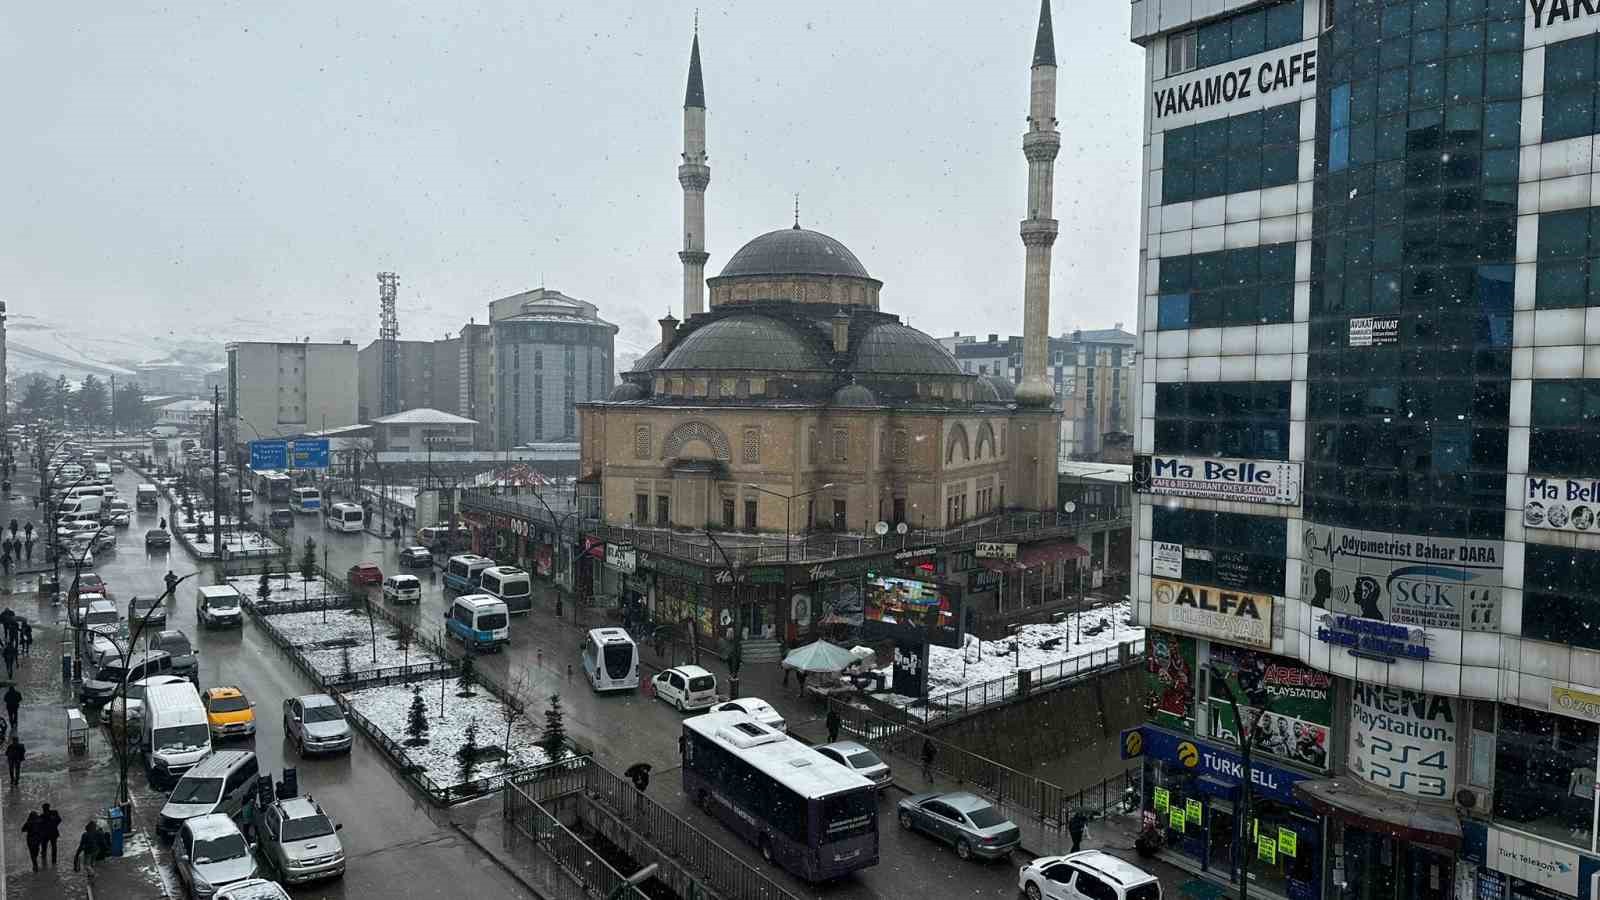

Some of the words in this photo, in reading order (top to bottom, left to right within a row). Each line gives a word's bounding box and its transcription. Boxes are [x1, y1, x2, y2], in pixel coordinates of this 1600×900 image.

[1529, 0, 1600, 29] YAK
[1154, 66, 1252, 119] YAKAMOZ
[1257, 49, 1317, 95] CAFE
[1373, 319, 1399, 330] AVUKAT
[1154, 458, 1193, 479] Ma
[1204, 460, 1272, 484] Belle
[1177, 481, 1222, 492] RESTAURANT
[1243, 486, 1276, 496] SALONU
[1529, 478, 1559, 500] Ma
[1341, 533, 1416, 558] Odyometrist
[1416, 538, 1456, 561] Bahar
[1459, 545, 1496, 563] DARA
[1175, 586, 1262, 621] ALFA
[1396, 580, 1456, 608] SGK
[1263, 663, 1329, 687] ARENA
[1266, 685, 1328, 700] PLAYSTATION
[1371, 735, 1448, 771] PS4
[1370, 761, 1447, 797] PS3
[1499, 847, 1518, 860] Türk
[1519, 854, 1557, 872] Telekom
